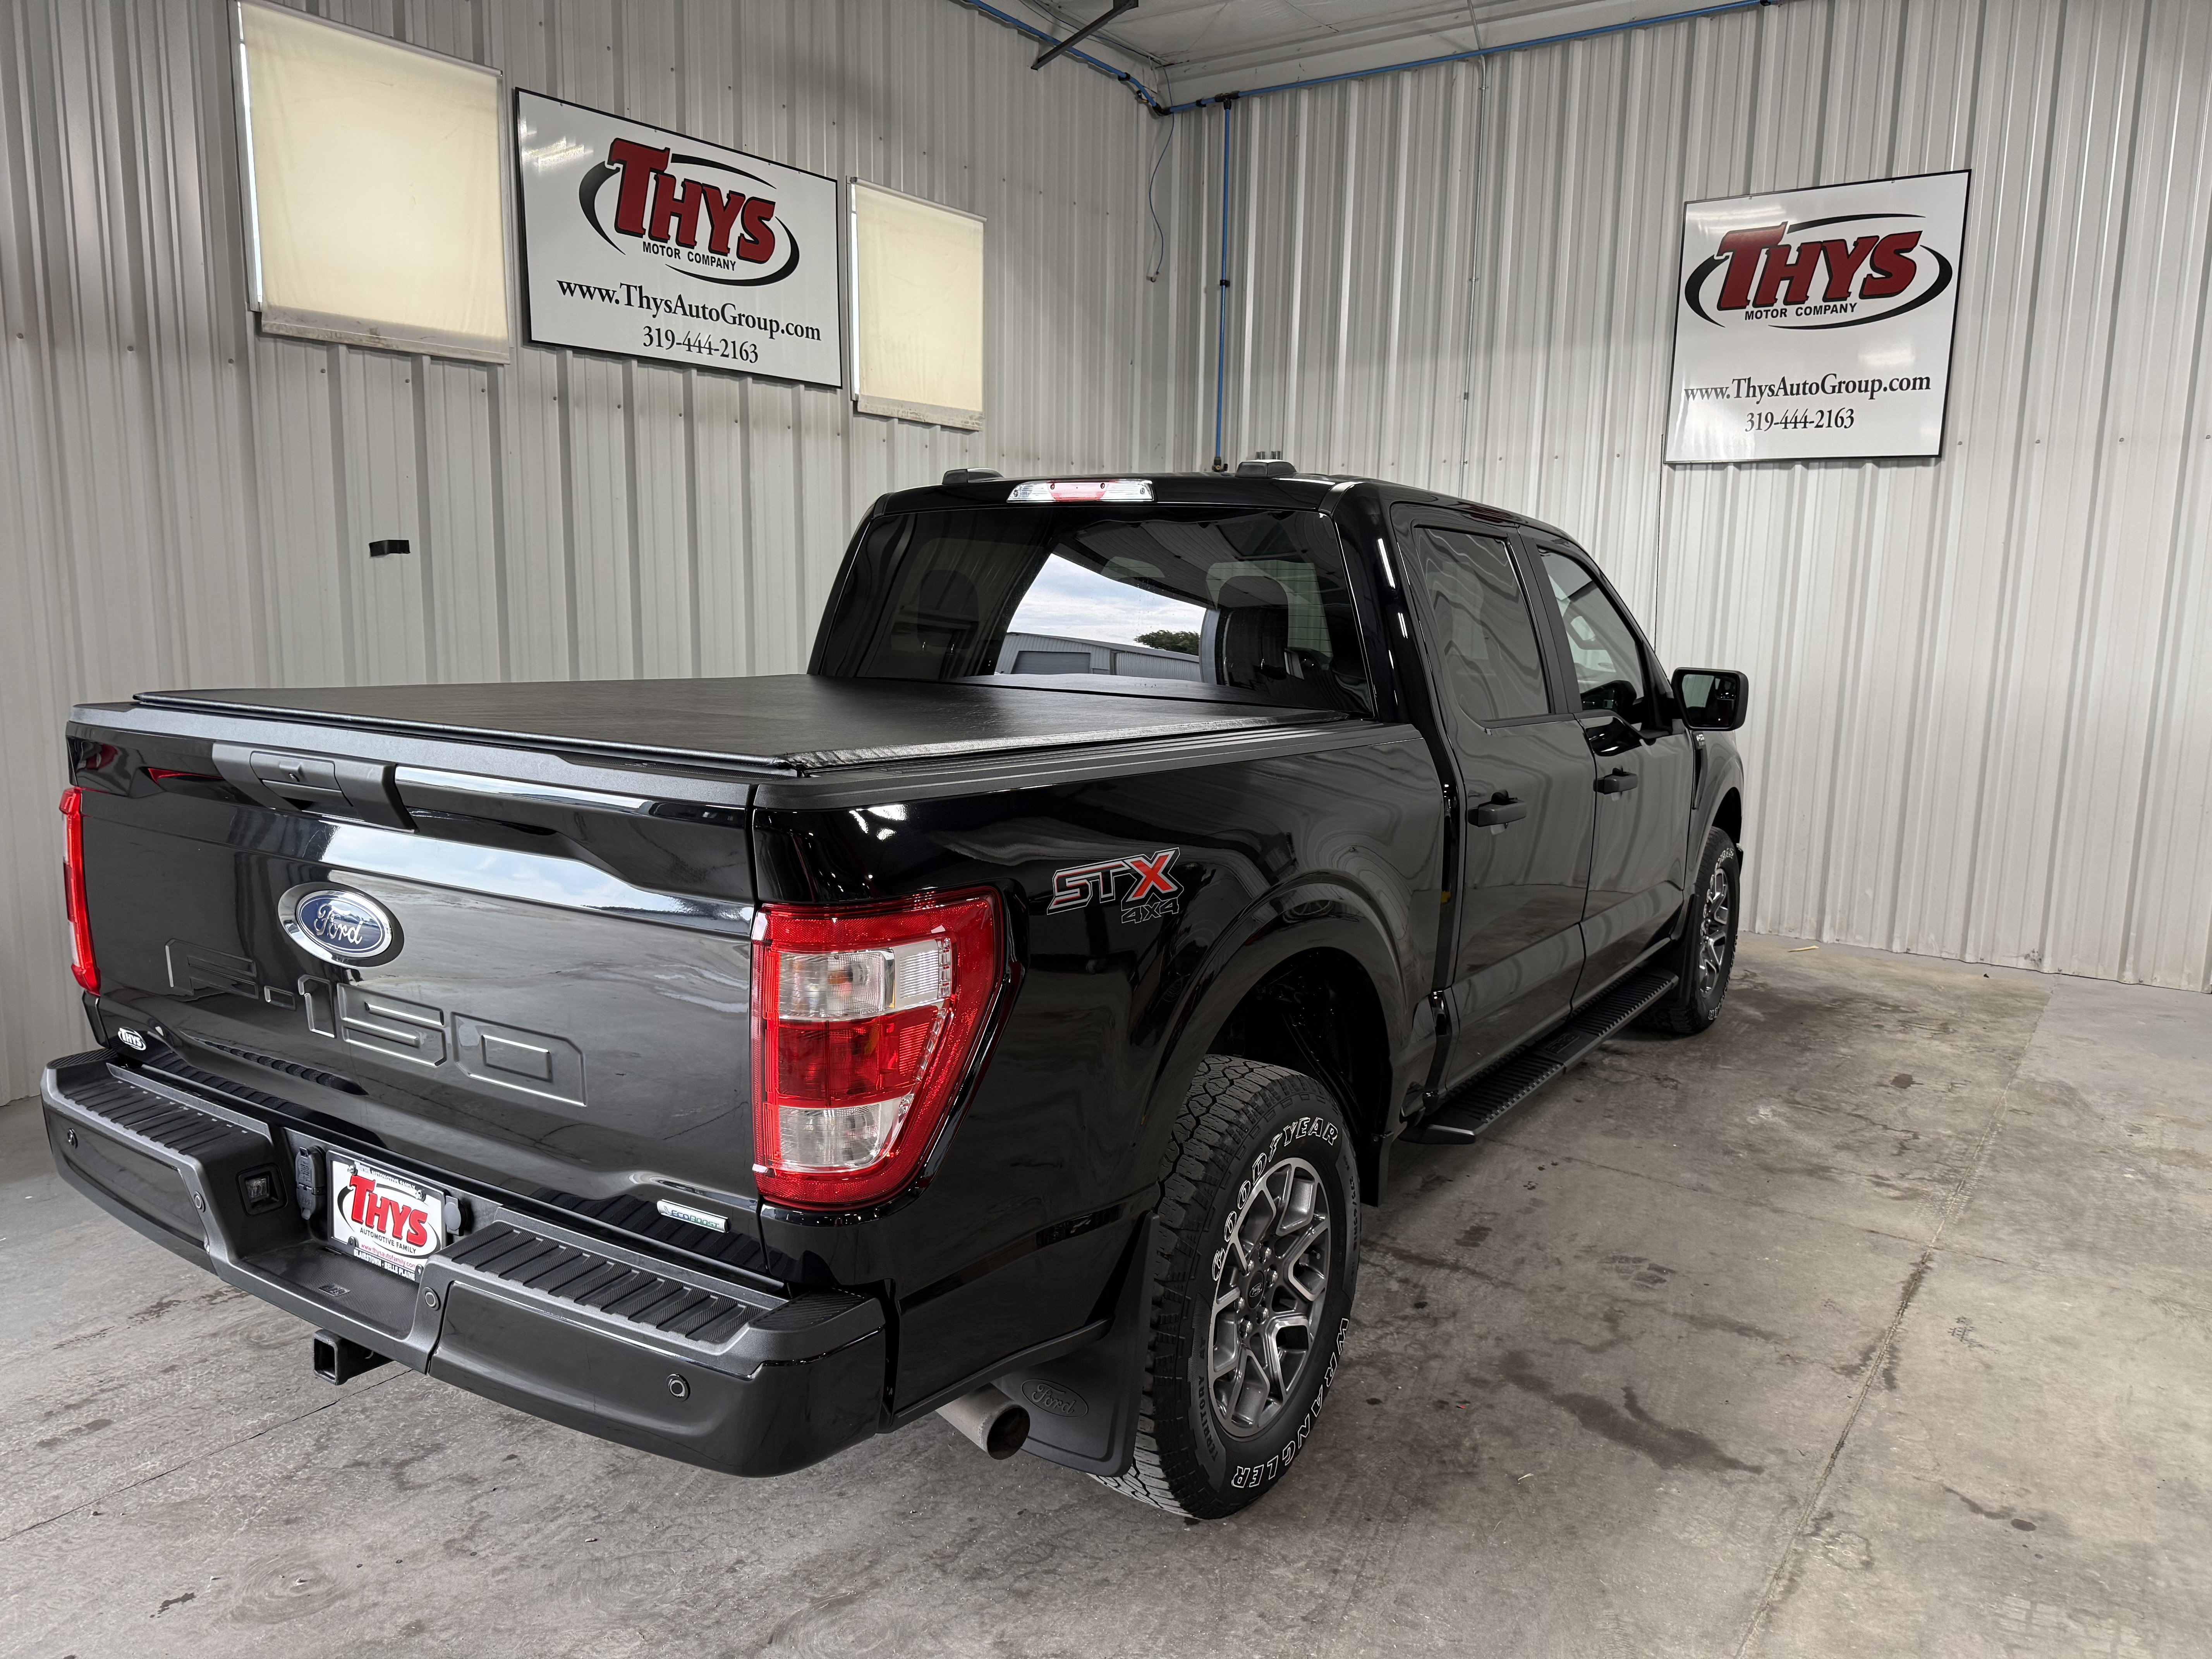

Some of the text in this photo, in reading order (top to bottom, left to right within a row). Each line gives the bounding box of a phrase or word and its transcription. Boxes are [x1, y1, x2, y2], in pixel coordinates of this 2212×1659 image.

[608, 138, 776, 264] THYS
[643, 241, 736, 271] MOTOR COMPANY
[1716, 221, 1923, 311] THYS
[556, 280, 821, 341] www.ThysAutoGroup.com
[1745, 302, 1857, 321] MOTOR COMPANY
[643, 326, 759, 364] 319-444-2163
[1684, 373, 1931, 404] www.ThysAutoGroup.com
[1745, 408, 1855, 431] 319-444-2163
[1047, 847, 1184, 915] STX
[314, 903, 364, 944] Ford
[119, 1027, 142, 1046] THYS
[165, 938, 587, 1106] F-150
[350, 1175, 428, 1247] THYS
[1212, 1116, 1339, 1281] GOODYEAR
[671, 1209, 719, 1228] ECOBOOST
[360, 1227, 416, 1254] AUTOMOTIVE FAMILY
[354, 1249, 416, 1281] BLAIRSTOWN BELLE PLAINE
[1032, 1383, 1077, 1414] Ford
[1231, 1318, 1349, 1488] WRANGLER
[1198, 1376, 1219, 1462] TERRITORY
